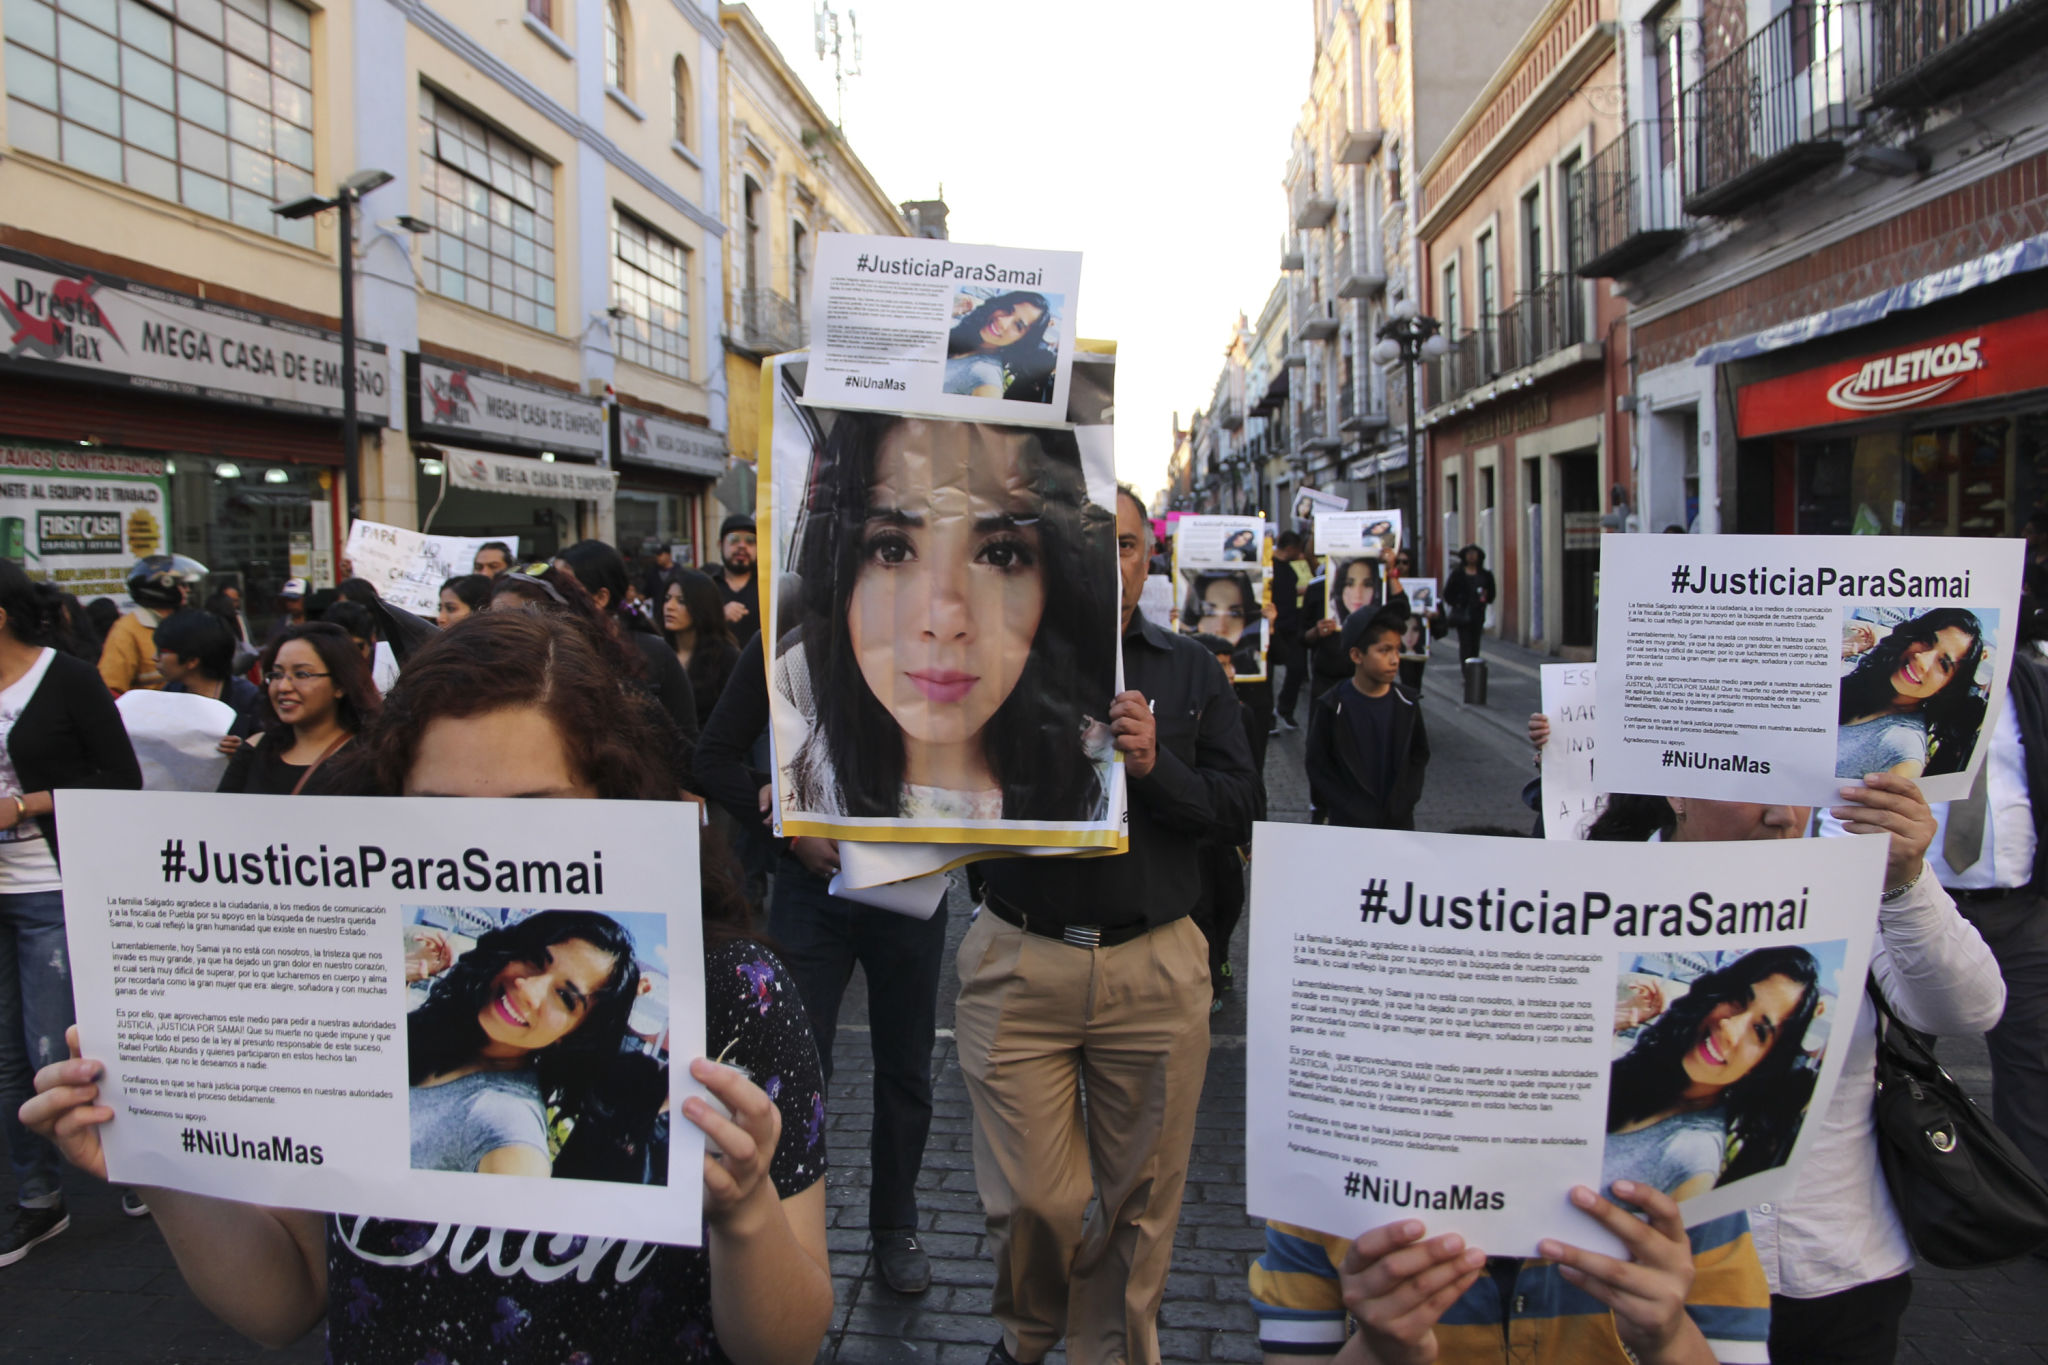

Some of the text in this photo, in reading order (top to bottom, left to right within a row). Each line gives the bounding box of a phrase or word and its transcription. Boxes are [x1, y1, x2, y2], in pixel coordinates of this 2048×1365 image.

[857, 253, 1043, 286] #JusticiaParaSamai
[15, 278, 101, 328] Presta
[51, 325, 103, 363] Max
[142, 321, 385, 397] MEGA CASA DE EMEÑO
[845, 376, 906, 391] #NiUnaMas
[486, 396, 518, 420] MEGA
[520, 404, 547, 427] CASA
[551, 410, 563, 431] DE
[56, 452, 164, 476] CONTRATANDO
[531, 472, 558, 488] CASA
[561, 474, 574, 489] DE
[31, 484, 46, 499] AL
[49, 485, 92, 501] EQUIPO
[95, 487, 109, 502] DE
[112, 487, 159, 503] TRABAJO
[1672, 565, 1970, 599] #JusticiaParaSamai
[1563, 670, 1597, 686] ES
[1662, 750, 1771, 775] #NiUnaMas
[161, 840, 603, 895] #JusticiaParaSamai
[107, 896, 117, 904] La
[118, 896, 143, 905] familia
[145, 898, 175, 908] Salgado
[176, 899, 211, 909] agradece
[219, 900, 227, 908] la
[280, 902, 292, 911] los
[293, 903, 321, 912] medios
[322, 904, 332, 912] de
[1360, 879, 1808, 936] #JusticiaParaSamai
[121, 908, 128, 916] la
[158, 909, 168, 918] de
[169, 910, 196, 918] Puebla
[196, 912, 209, 921] por
[222, 913, 245, 922] apoyo
[258, 913, 265, 921] la
[306, 914, 315, 923] de
[317, 916, 346, 924] nuestra
[347, 917, 376, 926] querida
[137, 920, 144, 928] lo
[146, 921, 161, 929] cual
[187, 922, 194, 930] la
[196, 924, 213, 932] gran
[214, 923, 256, 932] humanidad
[257, 926, 272, 934] que
[273, 925, 296, 934] existe
[309, 927, 338, 935] nuestro
[116, 1009, 126, 1017] Es
[128, 1011, 140, 1019] por
[158, 1012, 172, 1021] que
[174, 1013, 227, 1022] aprovechamos
[229, 1015, 245, 1023] este
[247, 1015, 270, 1024] medio
[272, 1018, 288, 1026] para
[290, 1017, 309, 1027] pedir
[318, 1019, 350, 1027] nuestras
[352, 1020, 395, 1029] autoridades
[197, 1023, 215, 1032] POR
[247, 1026, 263, 1034] Que
[275, 1028, 302, 1036] muerte
[315, 1030, 338, 1039] quede
[340, 1031, 368, 1042] impune
[377, 1035, 390, 1043] que
[118, 1042, 142, 1051] Rafael
[143, 1043, 168, 1052] Portillo
[169, 1045, 198, 1054] Abundis
[206, 1047, 235, 1057] quienes
[237, 1049, 280, 1060] participaron
[293, 1052, 314, 1060] estos
[315, 1052, 343, 1062] hechos
[345, 1054, 357, 1062] tan
[181, 1128, 324, 1165] #NiUnaMas
[1345, 1172, 1505, 1210] #NiUnaMas
